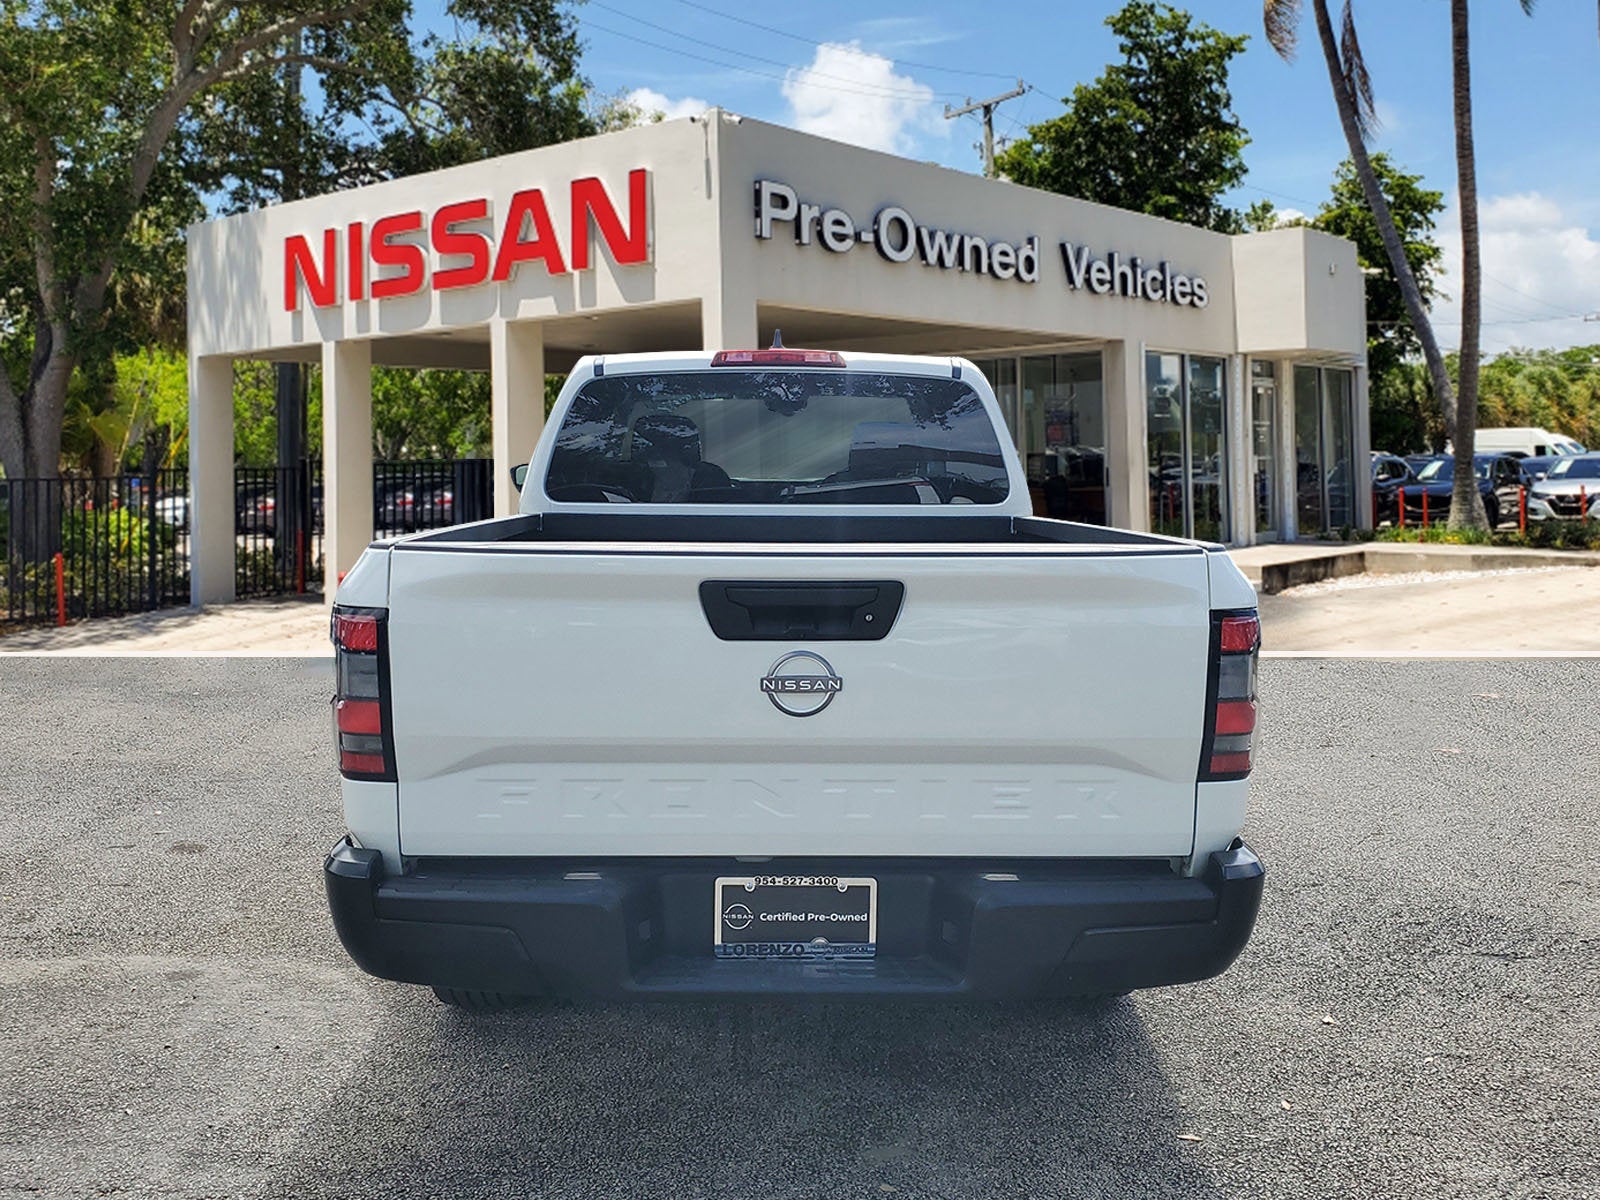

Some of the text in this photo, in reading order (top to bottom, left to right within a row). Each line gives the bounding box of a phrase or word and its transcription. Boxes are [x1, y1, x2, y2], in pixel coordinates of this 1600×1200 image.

[285, 169, 648, 312] NISSAN
[754, 180, 1209, 309] Pre-Owned Vehicles
[763, 680, 840, 690] NISSAN
[754, 876, 839, 887] 954-527-3400
[759, 913, 868, 922] Certified Pre-Owned
[723, 944, 805, 956] LORENZO
